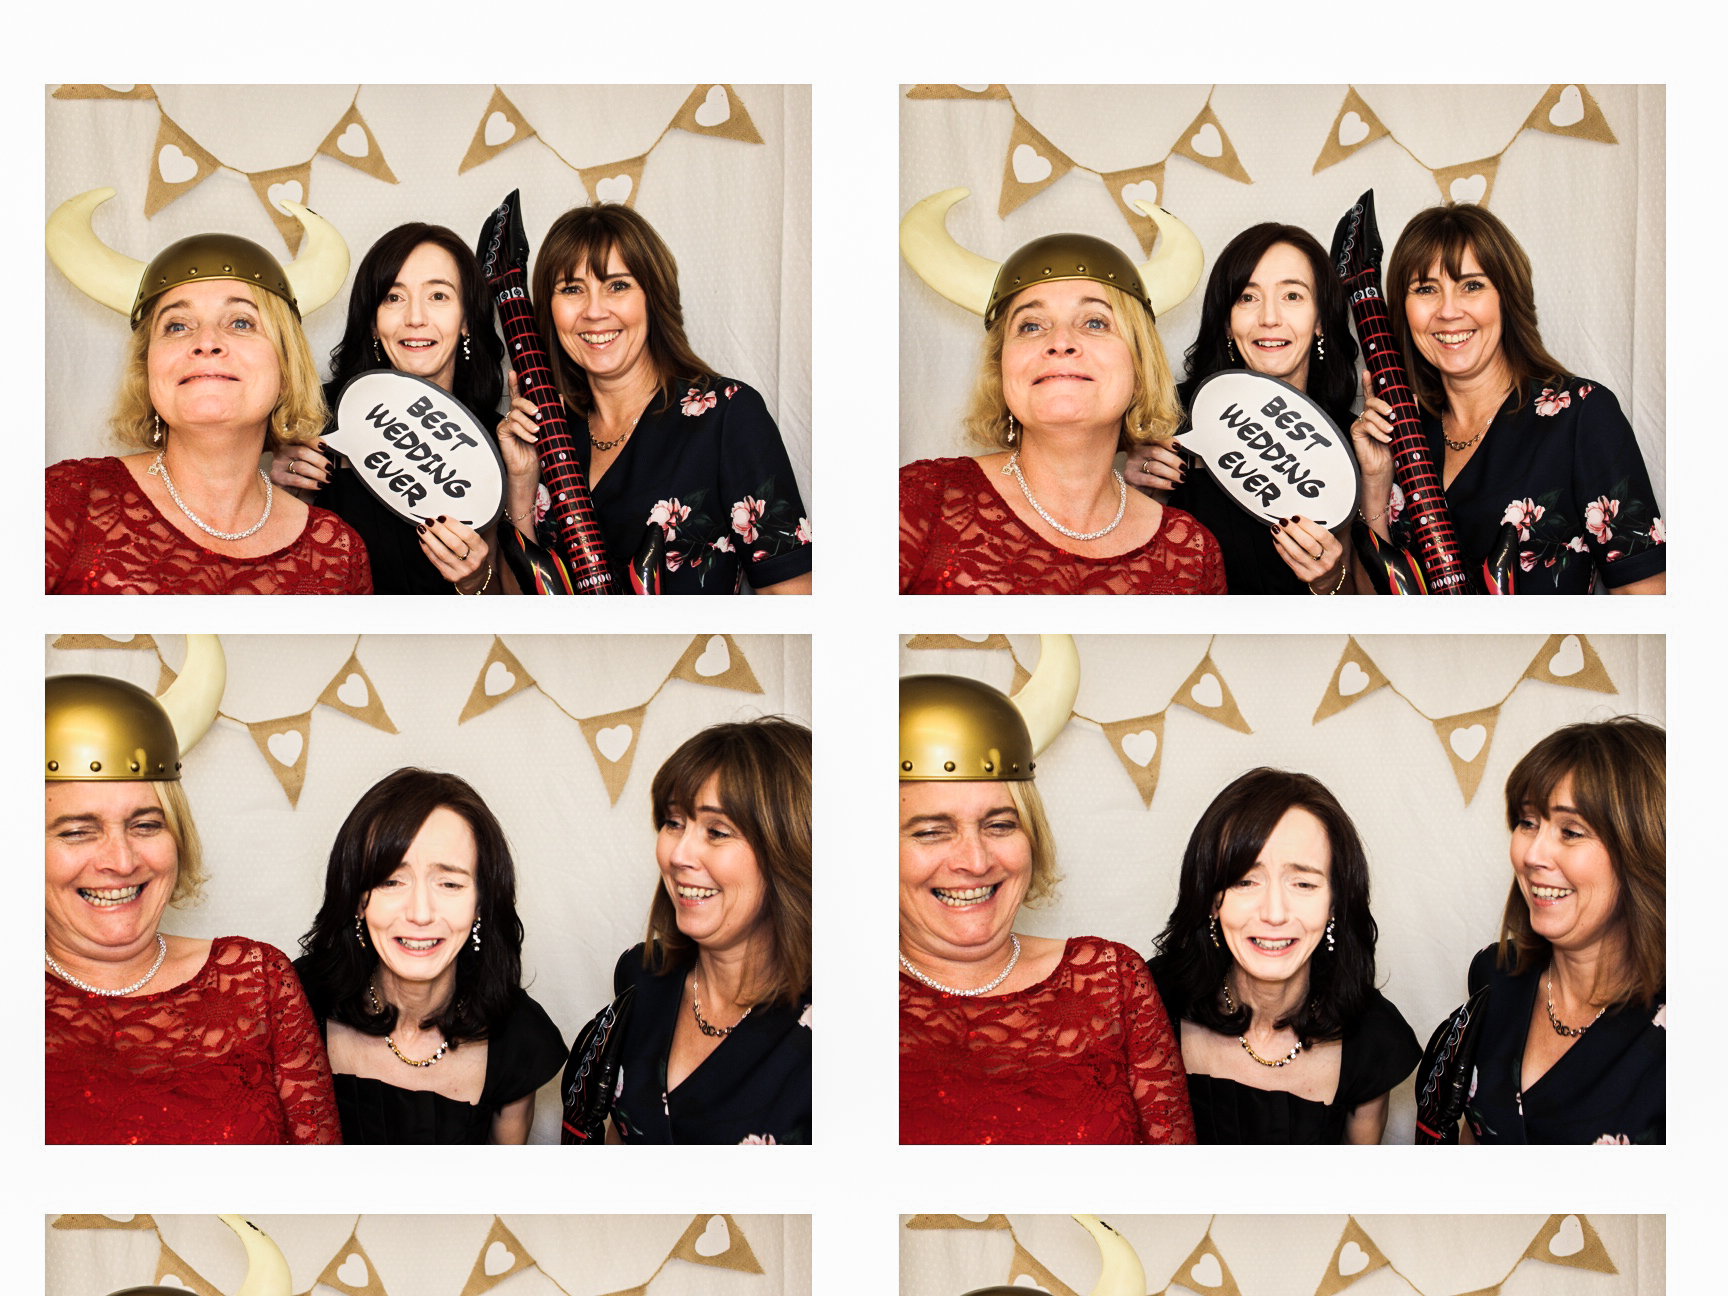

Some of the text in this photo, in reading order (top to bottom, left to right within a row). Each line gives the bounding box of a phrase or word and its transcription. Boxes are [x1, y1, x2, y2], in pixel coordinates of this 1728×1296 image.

[365, 402, 472, 498] WEDDING
[406, 395, 479, 452] BEST
[1219, 402, 1326, 498] WEDDING
[1260, 395, 1333, 452] BEST
[363, 450, 428, 508] EVER
[1217, 450, 1282, 508] EVER
